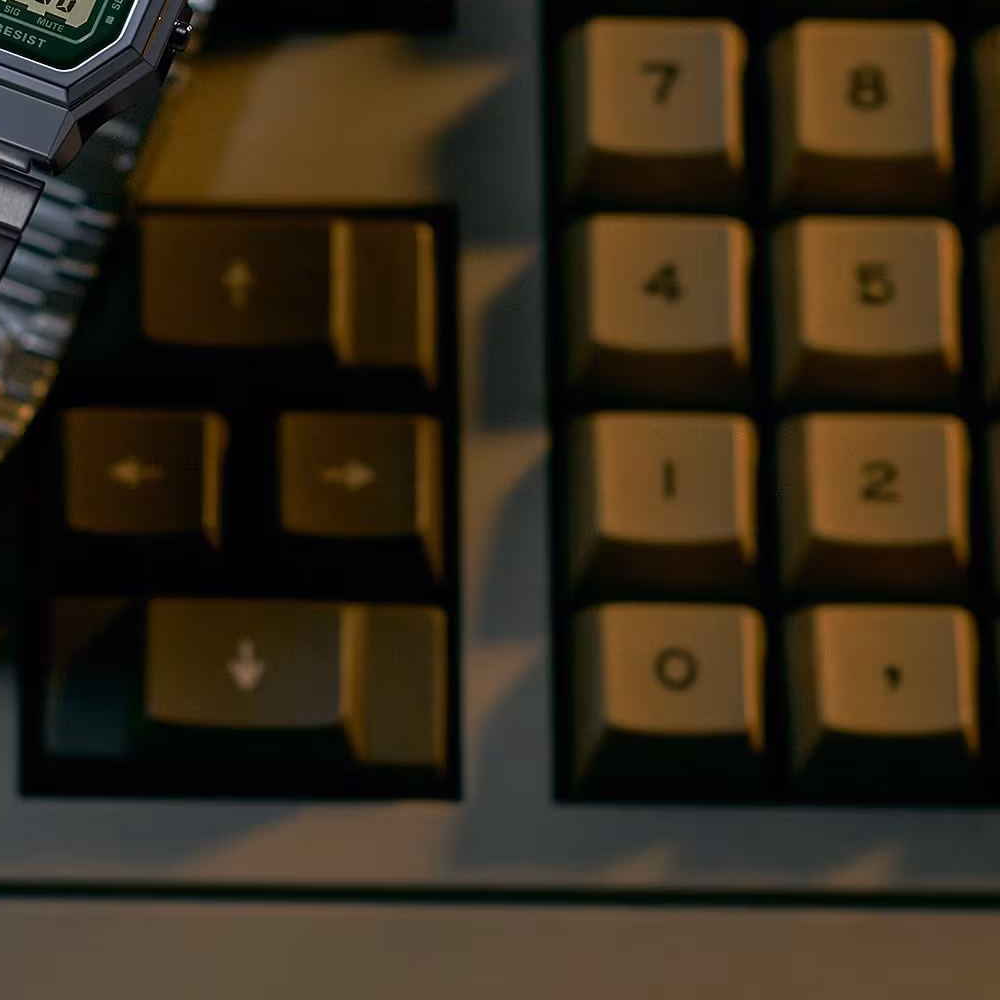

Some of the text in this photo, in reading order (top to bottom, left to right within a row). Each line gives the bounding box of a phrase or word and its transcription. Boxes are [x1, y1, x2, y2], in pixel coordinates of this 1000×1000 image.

[3, 4, 21, 17] SIG
[36, 17, 64, 33] MUTE
[640, 62, 681, 106] 7
[847, 64, 889, 111] 8
[642, 262, 684, 304] 4
[855, 261, 894, 305] 5
[660, 458, 678, 499] 1
[858, 460, 900, 502] 2
[652, 646, 698, 692] 0
